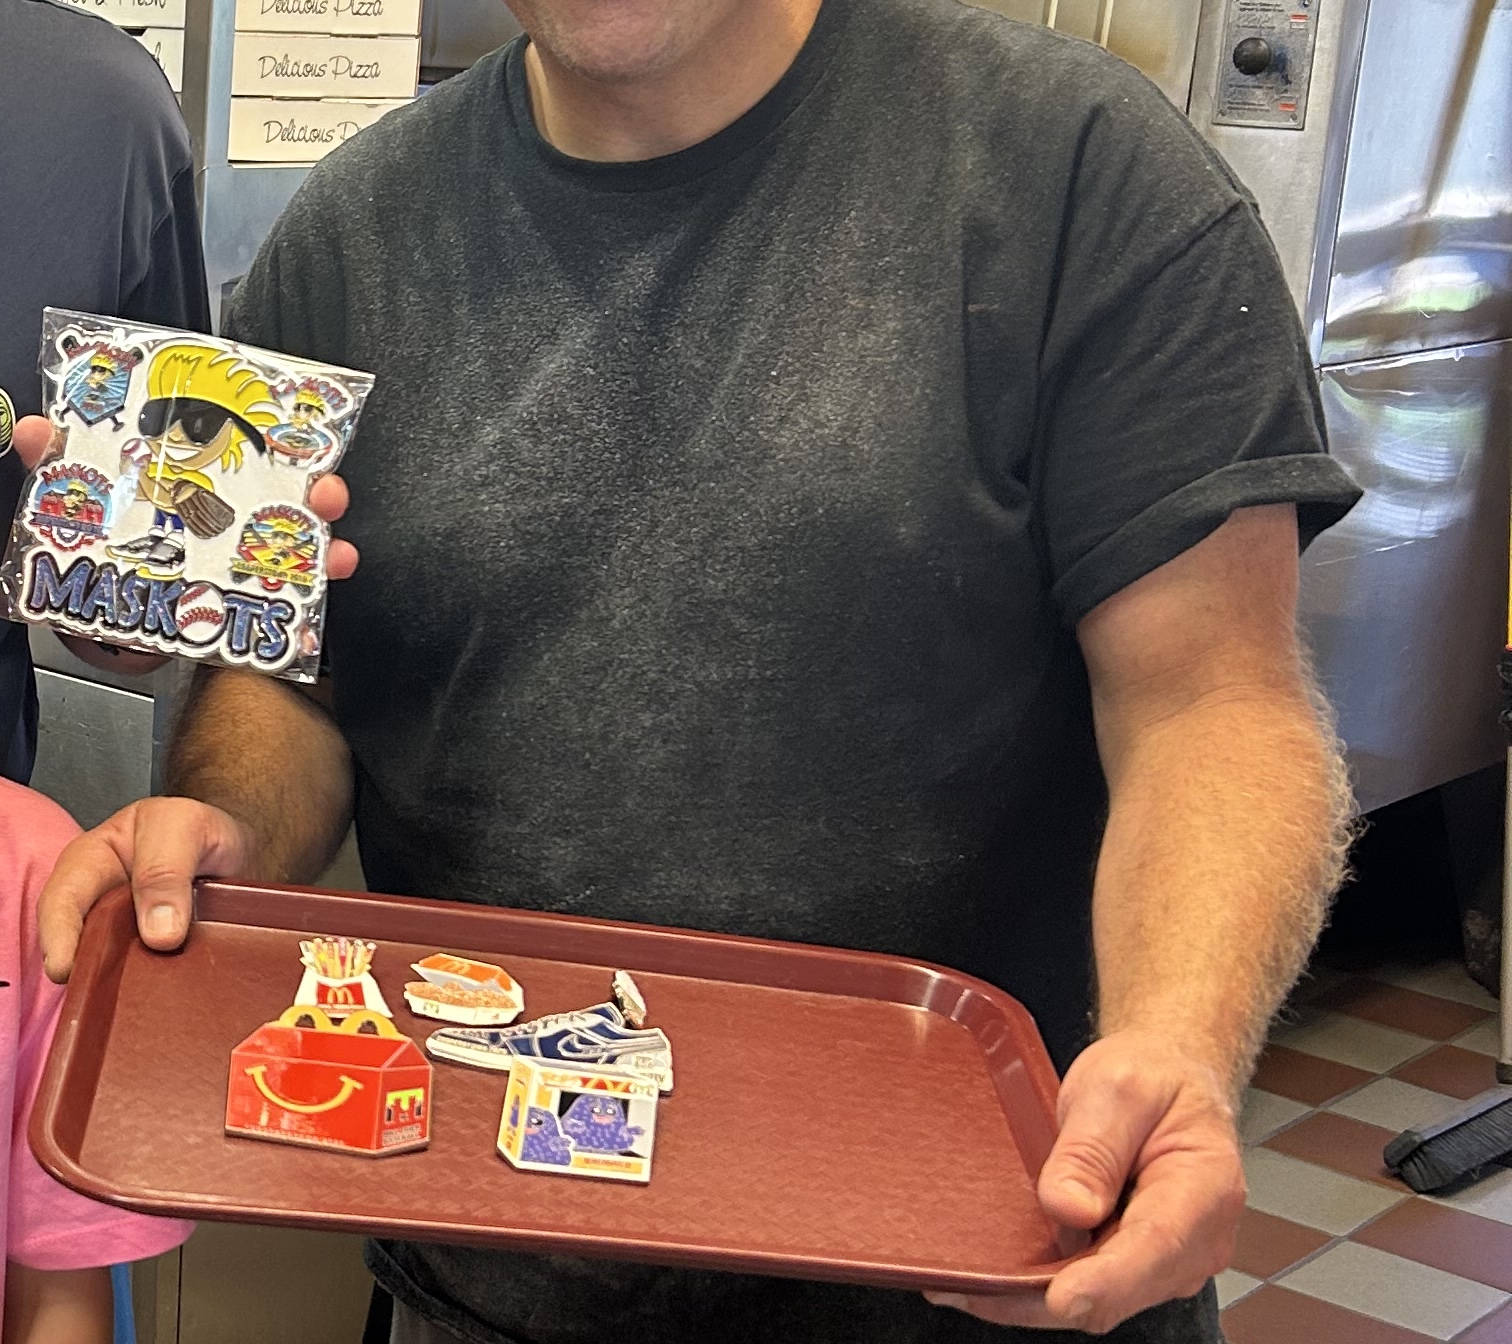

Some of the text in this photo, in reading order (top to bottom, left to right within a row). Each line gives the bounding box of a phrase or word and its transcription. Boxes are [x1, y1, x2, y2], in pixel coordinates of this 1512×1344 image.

[257, 52, 381, 81] Delicious Pizza
[263, 117, 336, 145] Delicious
[26, 550, 296, 661] MASKOTS
